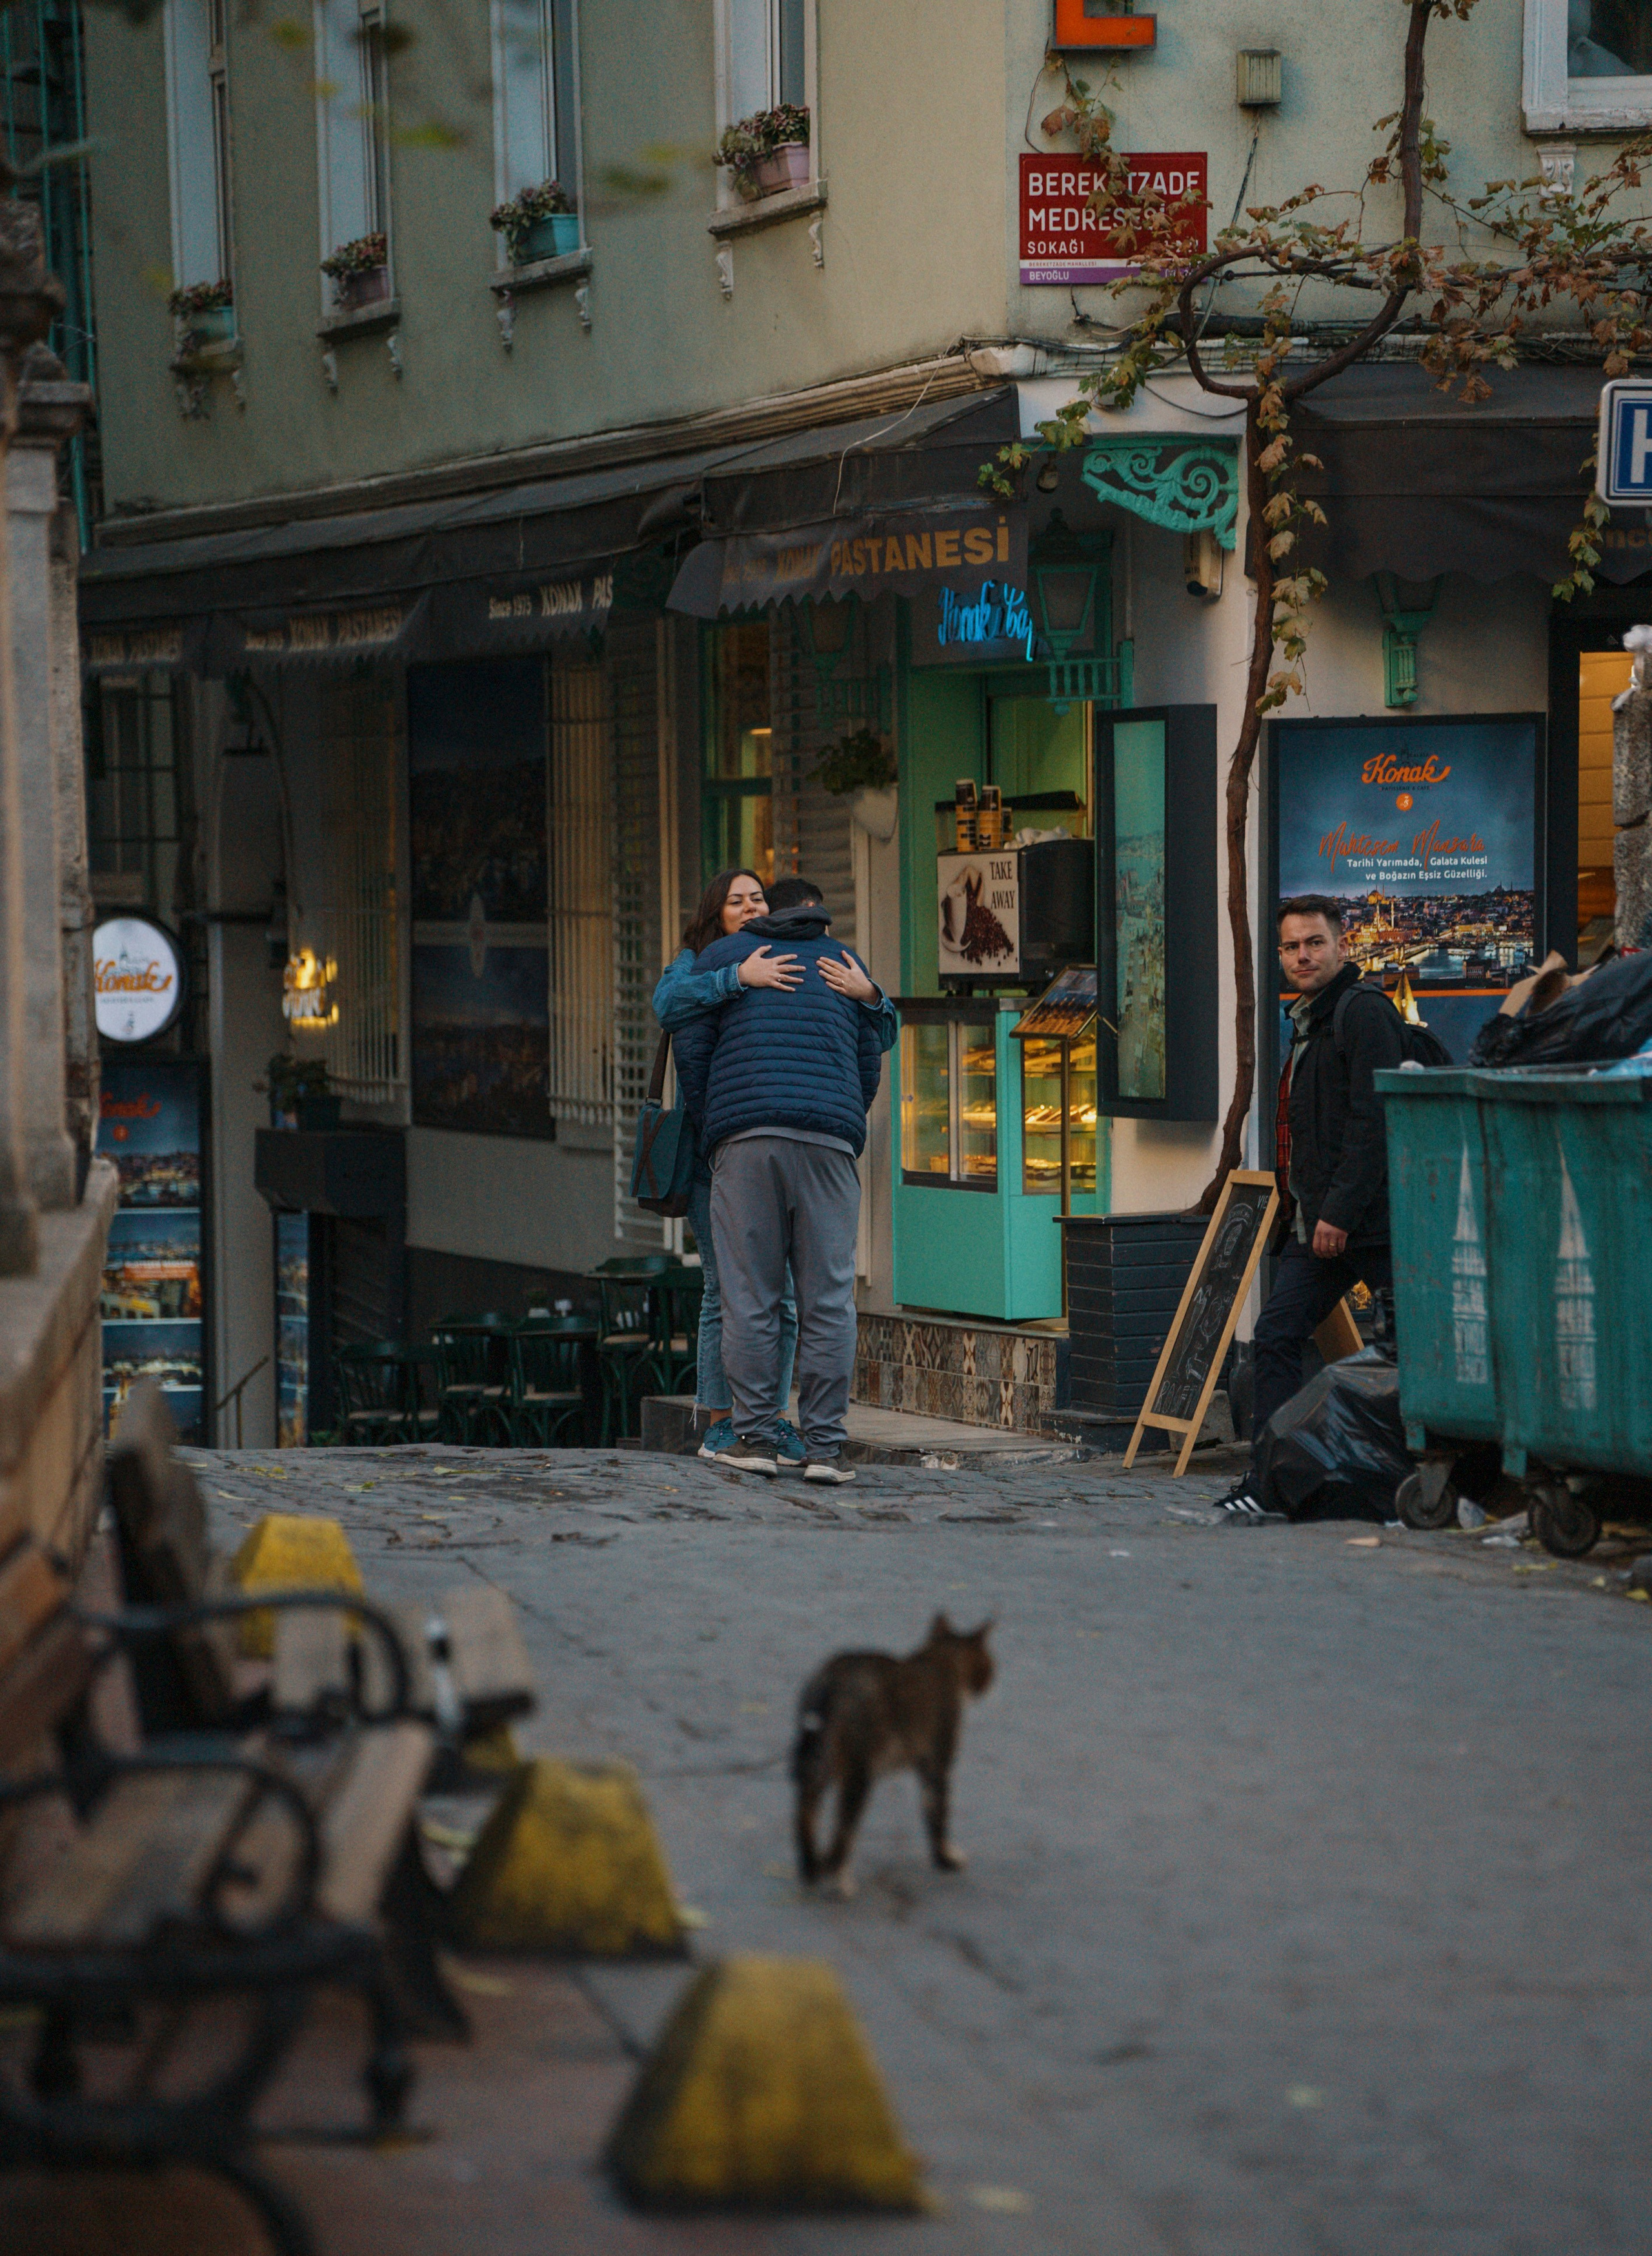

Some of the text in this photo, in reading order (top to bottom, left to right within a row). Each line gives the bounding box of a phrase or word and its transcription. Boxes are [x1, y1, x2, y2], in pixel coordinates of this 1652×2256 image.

[1029, 171, 1199, 196] BEREKTZADE
[1027, 239, 1085, 254] SOKAĞI
[1029, 270, 1069, 281] BEYOĞLU
[830, 516, 1009, 578] PASTANESİ
[539, 578, 582, 617] KONAK
[1361, 753, 1451, 784] Konak
[989, 861, 1012, 880] TAKE
[1347, 855, 1487, 868] Tarihi Yarımada, Galata Kulesi
[1379, 871, 1416, 882] Boğazın
[1418, 869, 1442, 880] Eşsiz
[1444, 868, 1487, 880] Güzelliği.
[991, 890, 1015, 910] AWAY
